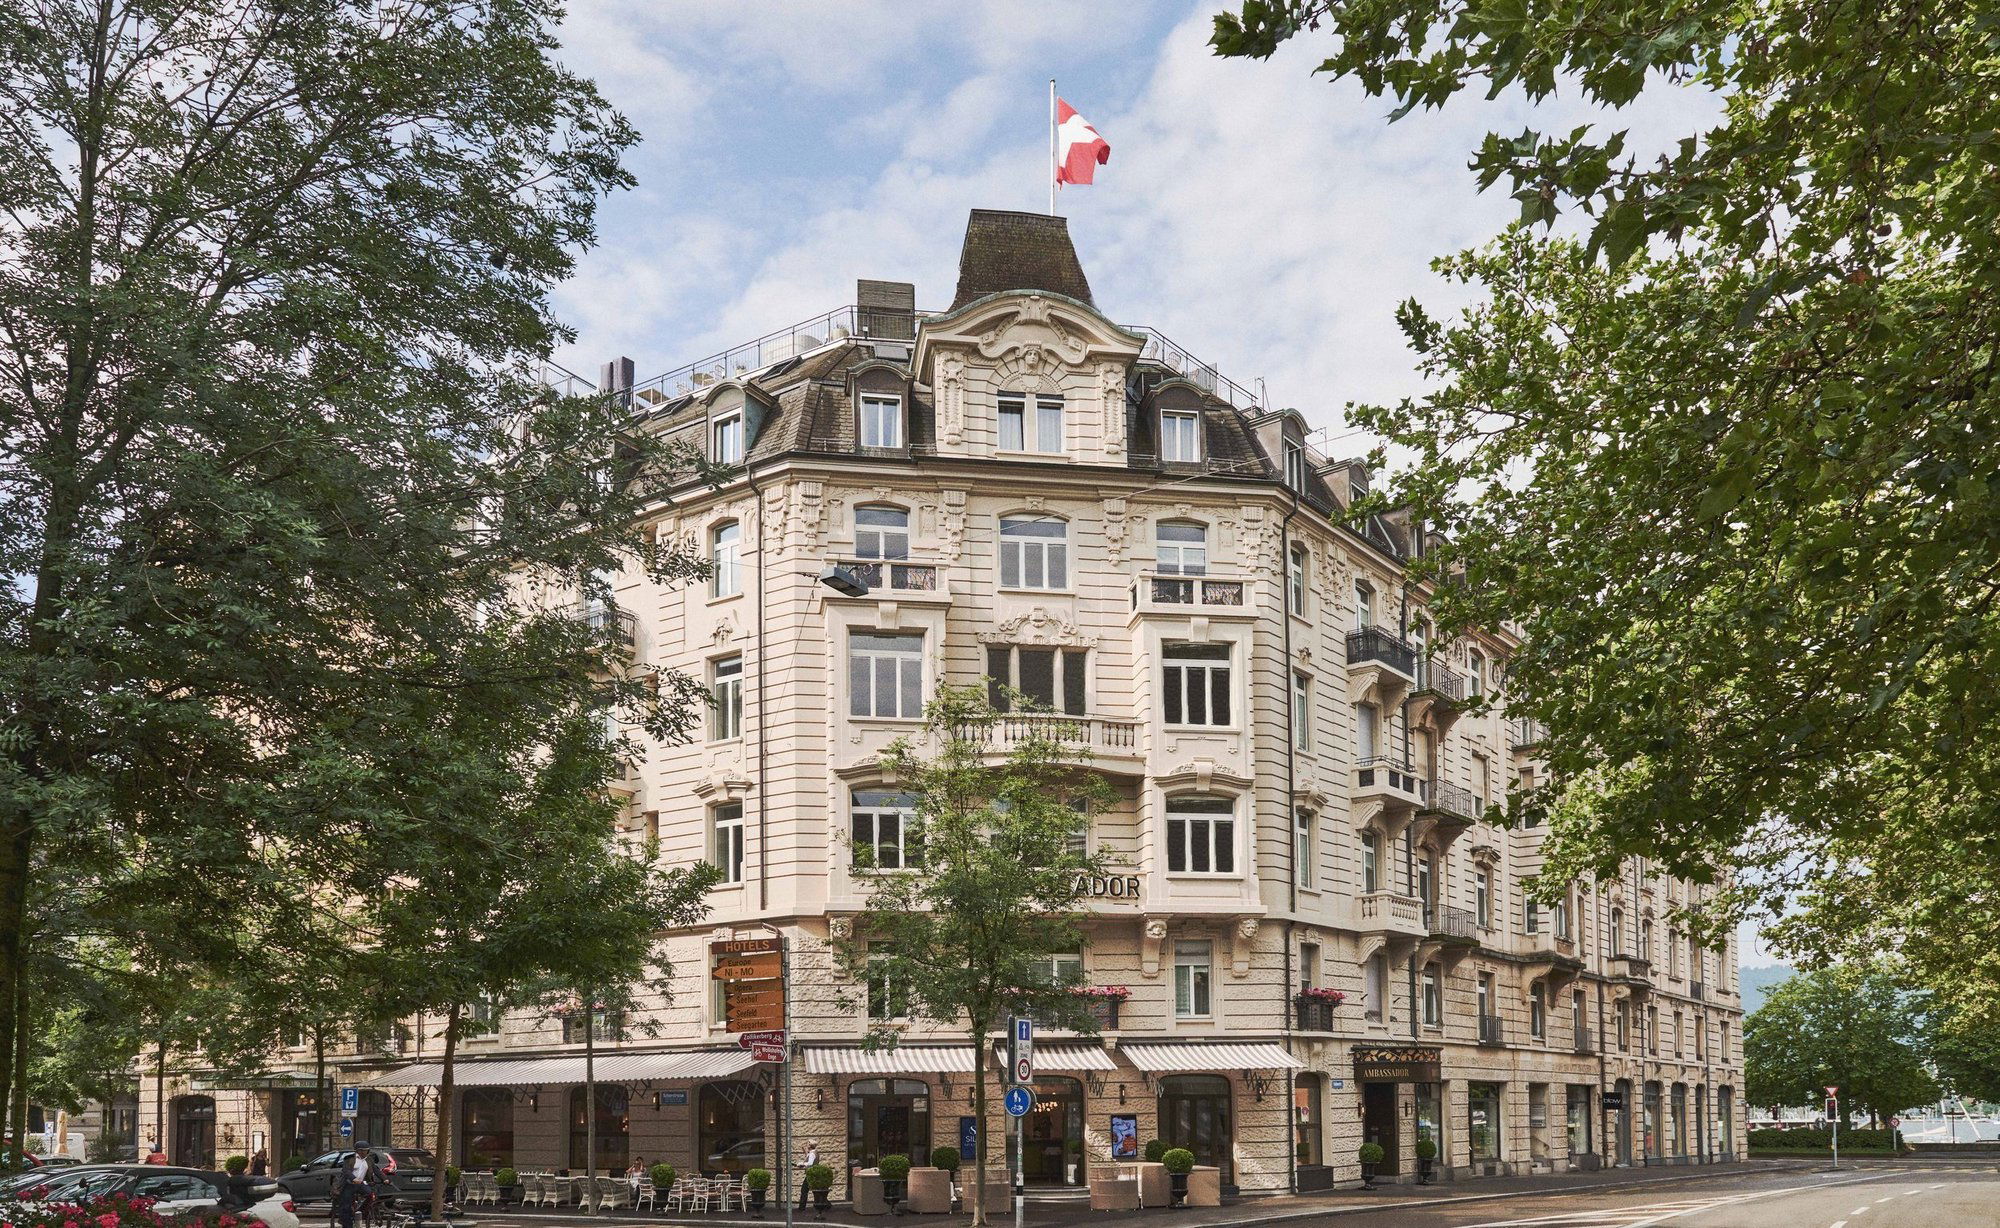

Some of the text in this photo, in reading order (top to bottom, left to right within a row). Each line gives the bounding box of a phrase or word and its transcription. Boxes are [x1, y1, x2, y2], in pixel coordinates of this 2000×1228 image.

[725, 940, 770, 952] HOTELS
[725, 969, 733, 977] NI
[740, 967, 754, 976] MO
[736, 994, 758, 1004] Seehof
[736, 1009, 758, 1018] Seefeld
[736, 1020, 768, 1030] Seegarten
[743, 1033, 773, 1041] Zollikerberg
[1021, 1065, 1028, 1074] 30
[1363, 1068, 1410, 1078] AMBASSADOR
[346, 1089, 354, 1101] P
